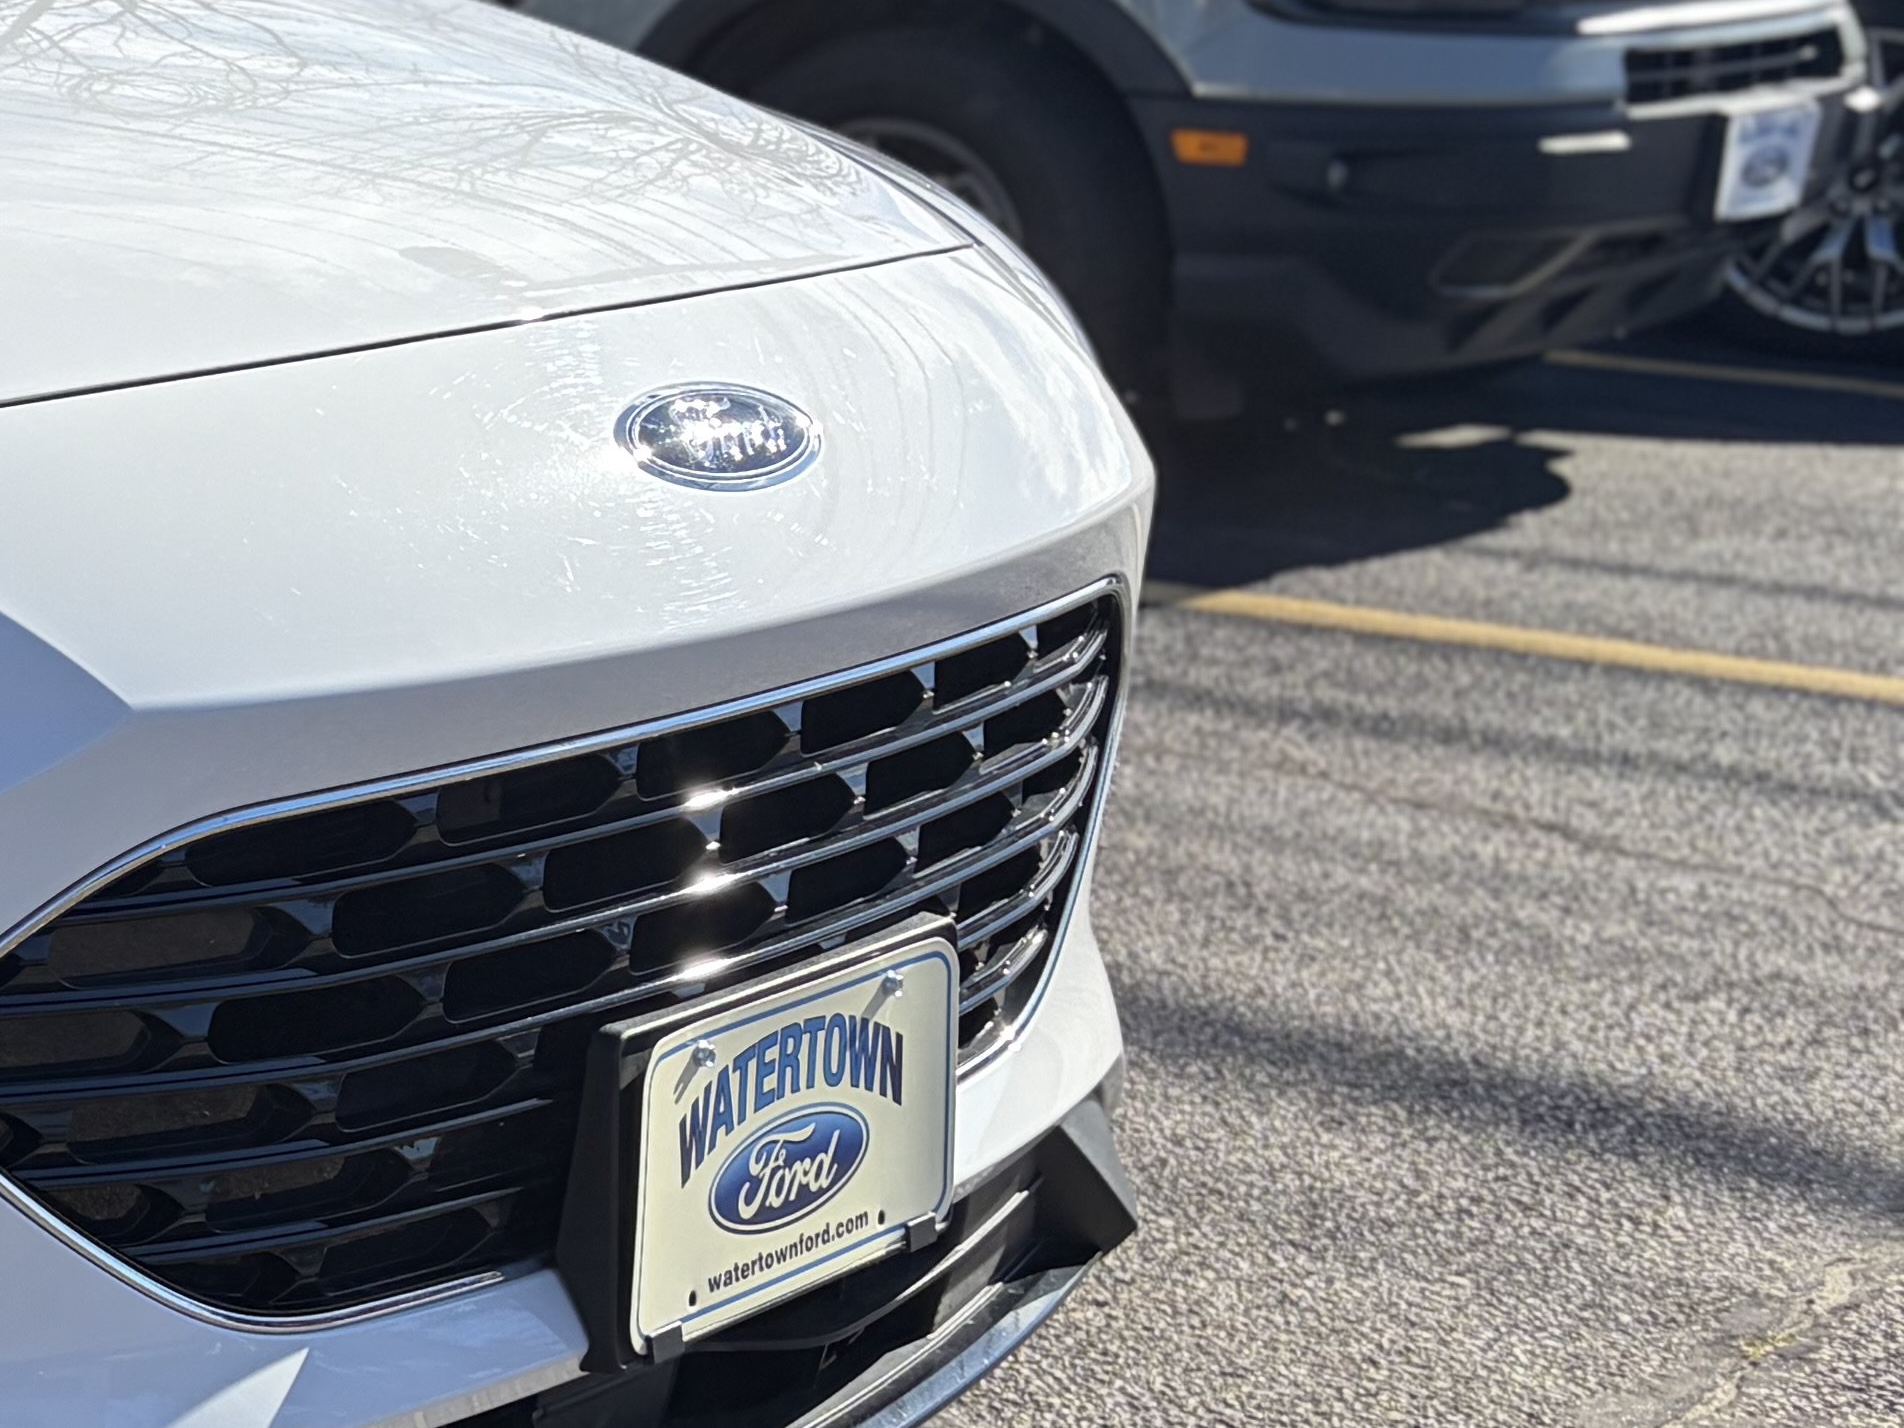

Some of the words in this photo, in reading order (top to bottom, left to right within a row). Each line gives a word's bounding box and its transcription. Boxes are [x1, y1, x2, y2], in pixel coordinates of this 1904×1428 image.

[677, 1012, 904, 1189] WATERTOWN
[738, 1122, 840, 1220] Ford
[707, 1210, 869, 1294] watertownford.com
